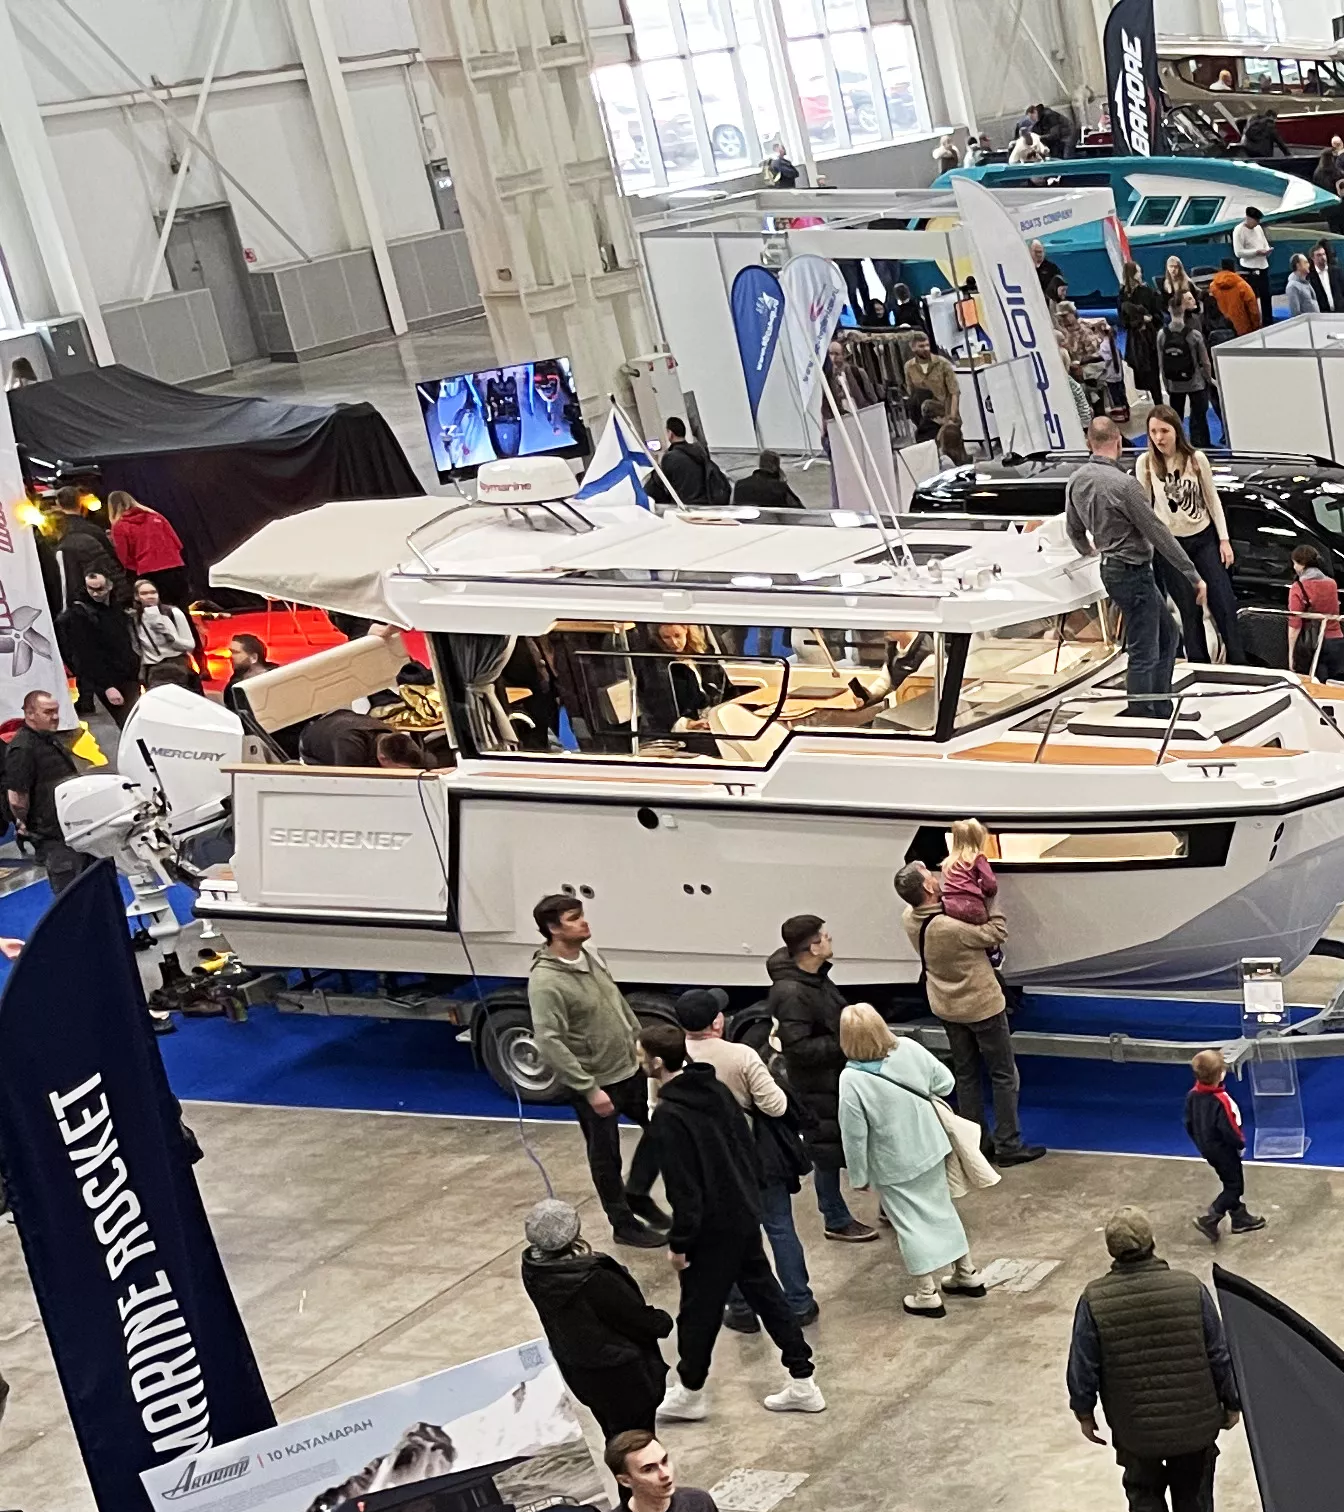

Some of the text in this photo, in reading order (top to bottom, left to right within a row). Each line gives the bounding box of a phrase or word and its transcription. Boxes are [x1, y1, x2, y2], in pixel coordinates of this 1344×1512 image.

[1121, 32, 1150, 157] BAKORE
[150, 747, 226, 763] MERCURY
[49, 1073, 212, 1457] MARINE ROCKET
[267, 1449, 283, 1463] 10
[285, 1419, 373, 1459] КАТАМАРАН
